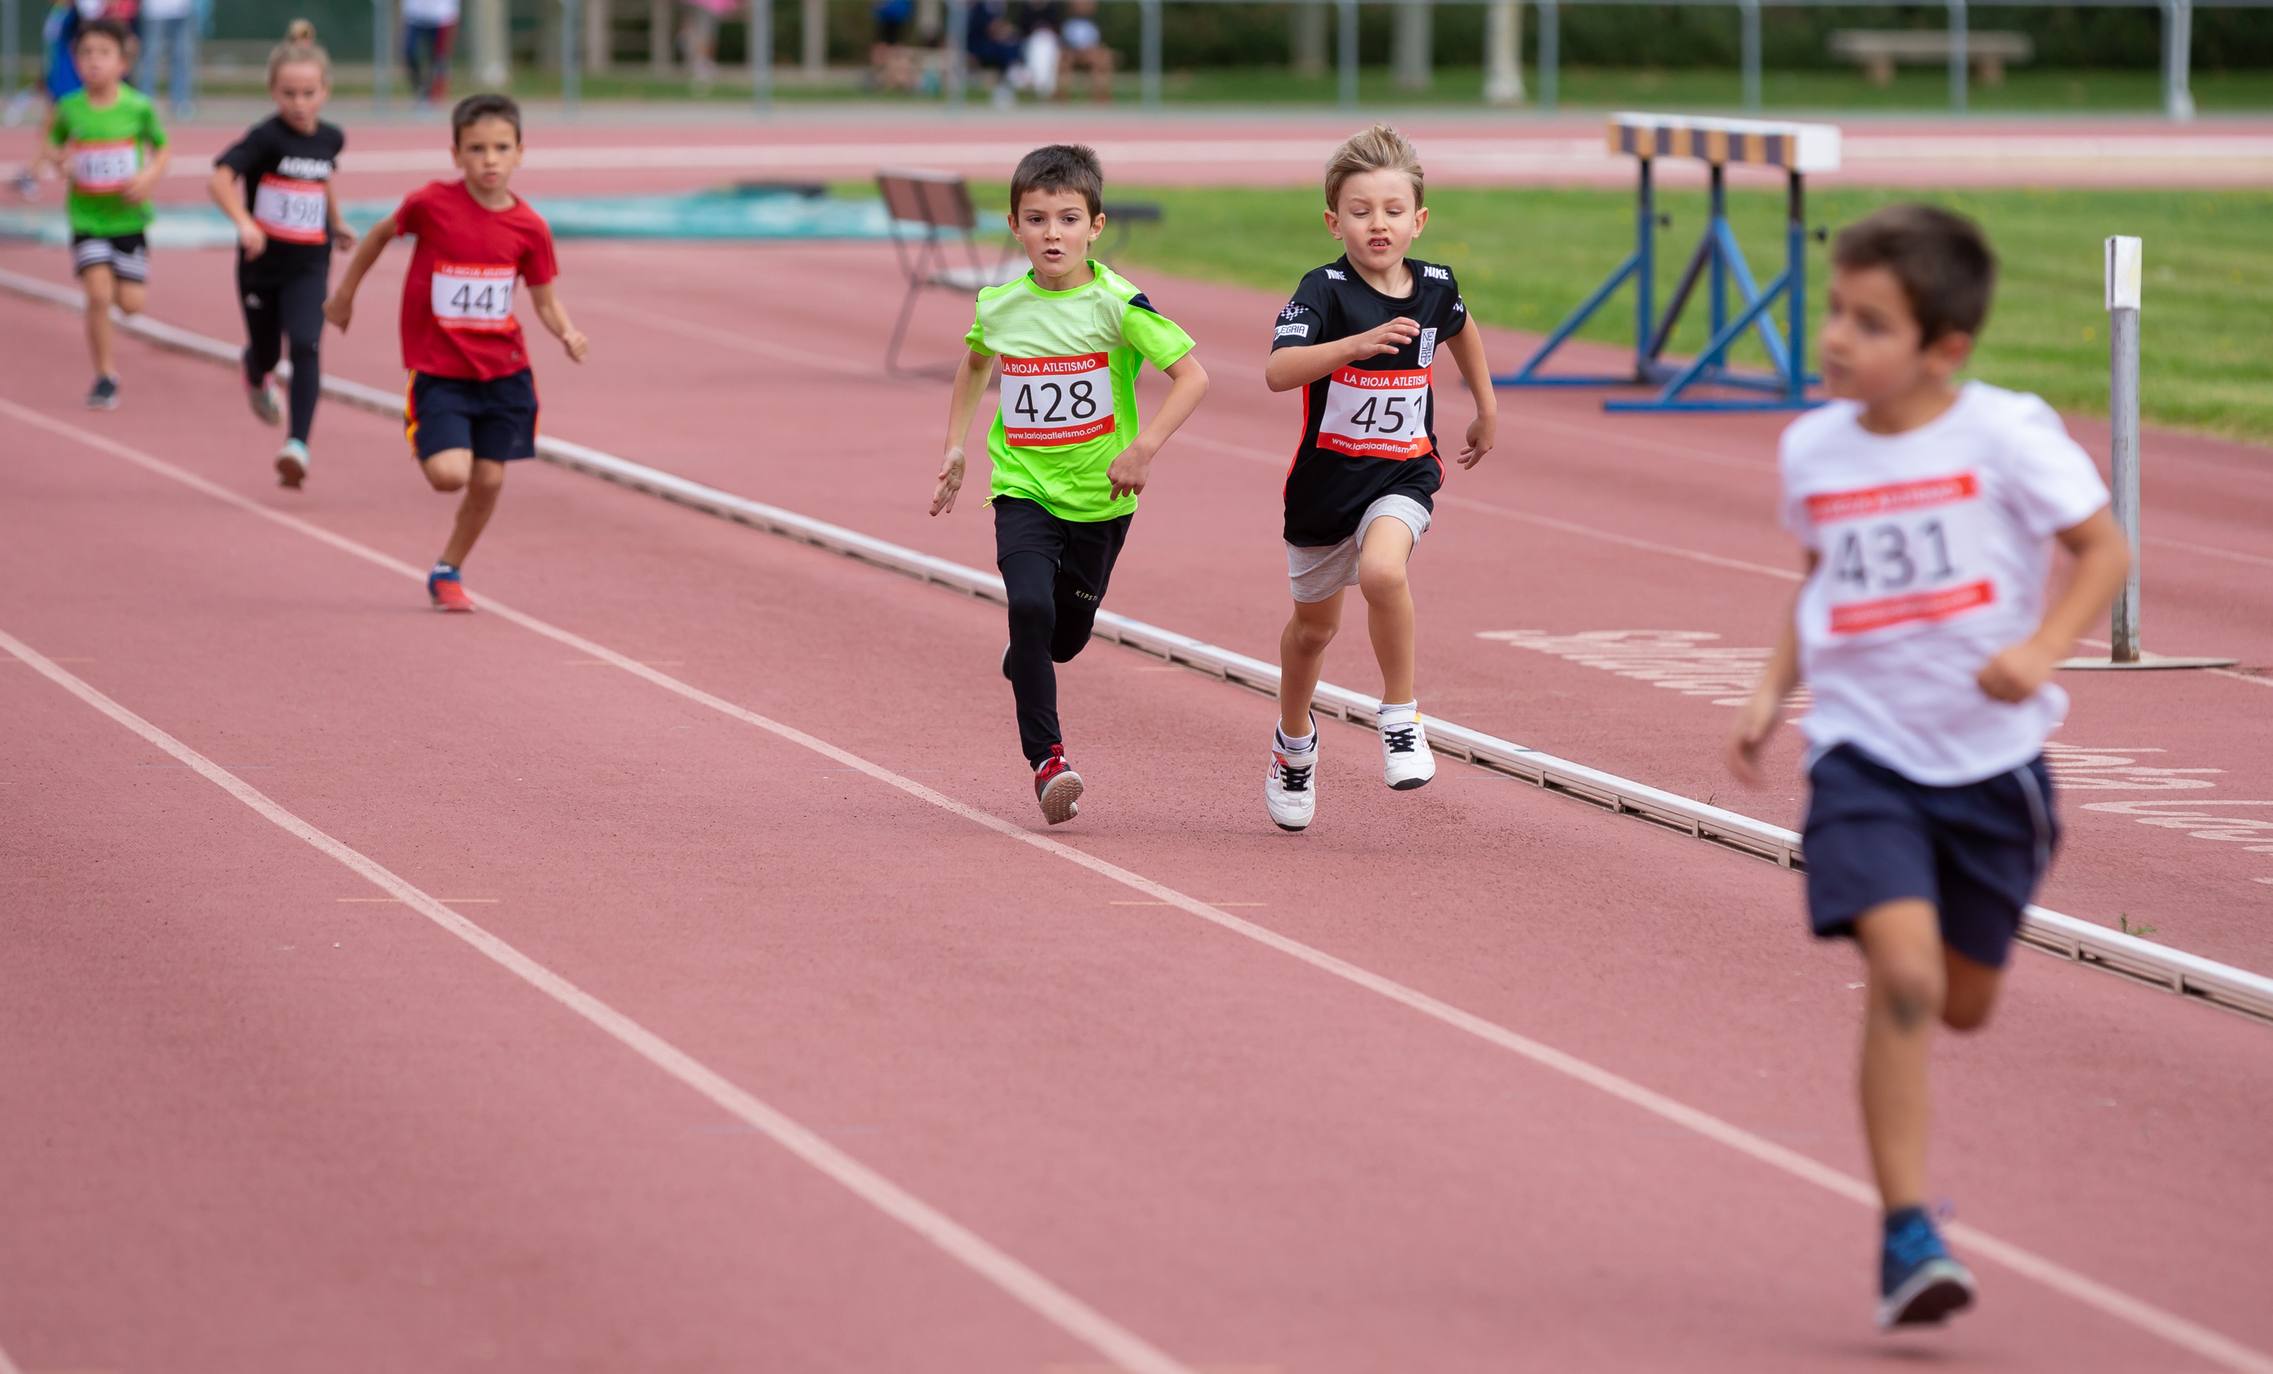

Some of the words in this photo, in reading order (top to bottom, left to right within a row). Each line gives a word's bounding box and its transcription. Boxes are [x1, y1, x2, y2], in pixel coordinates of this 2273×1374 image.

[1325, 268, 1347, 281] NIKE
[1423, 266, 1449, 280] NIKE
[450, 284, 510, 314] 441
[1002, 364, 1011, 373] LA
[1011, 363, 1040, 374] RIOJA
[1043, 359, 1096, 373] ATLETISMO
[1344, 373, 1357, 385] LA
[1360, 376, 1390, 387] RIOJA
[1014, 380, 1097, 423] 428
[1830, 518, 1957, 590] 431
